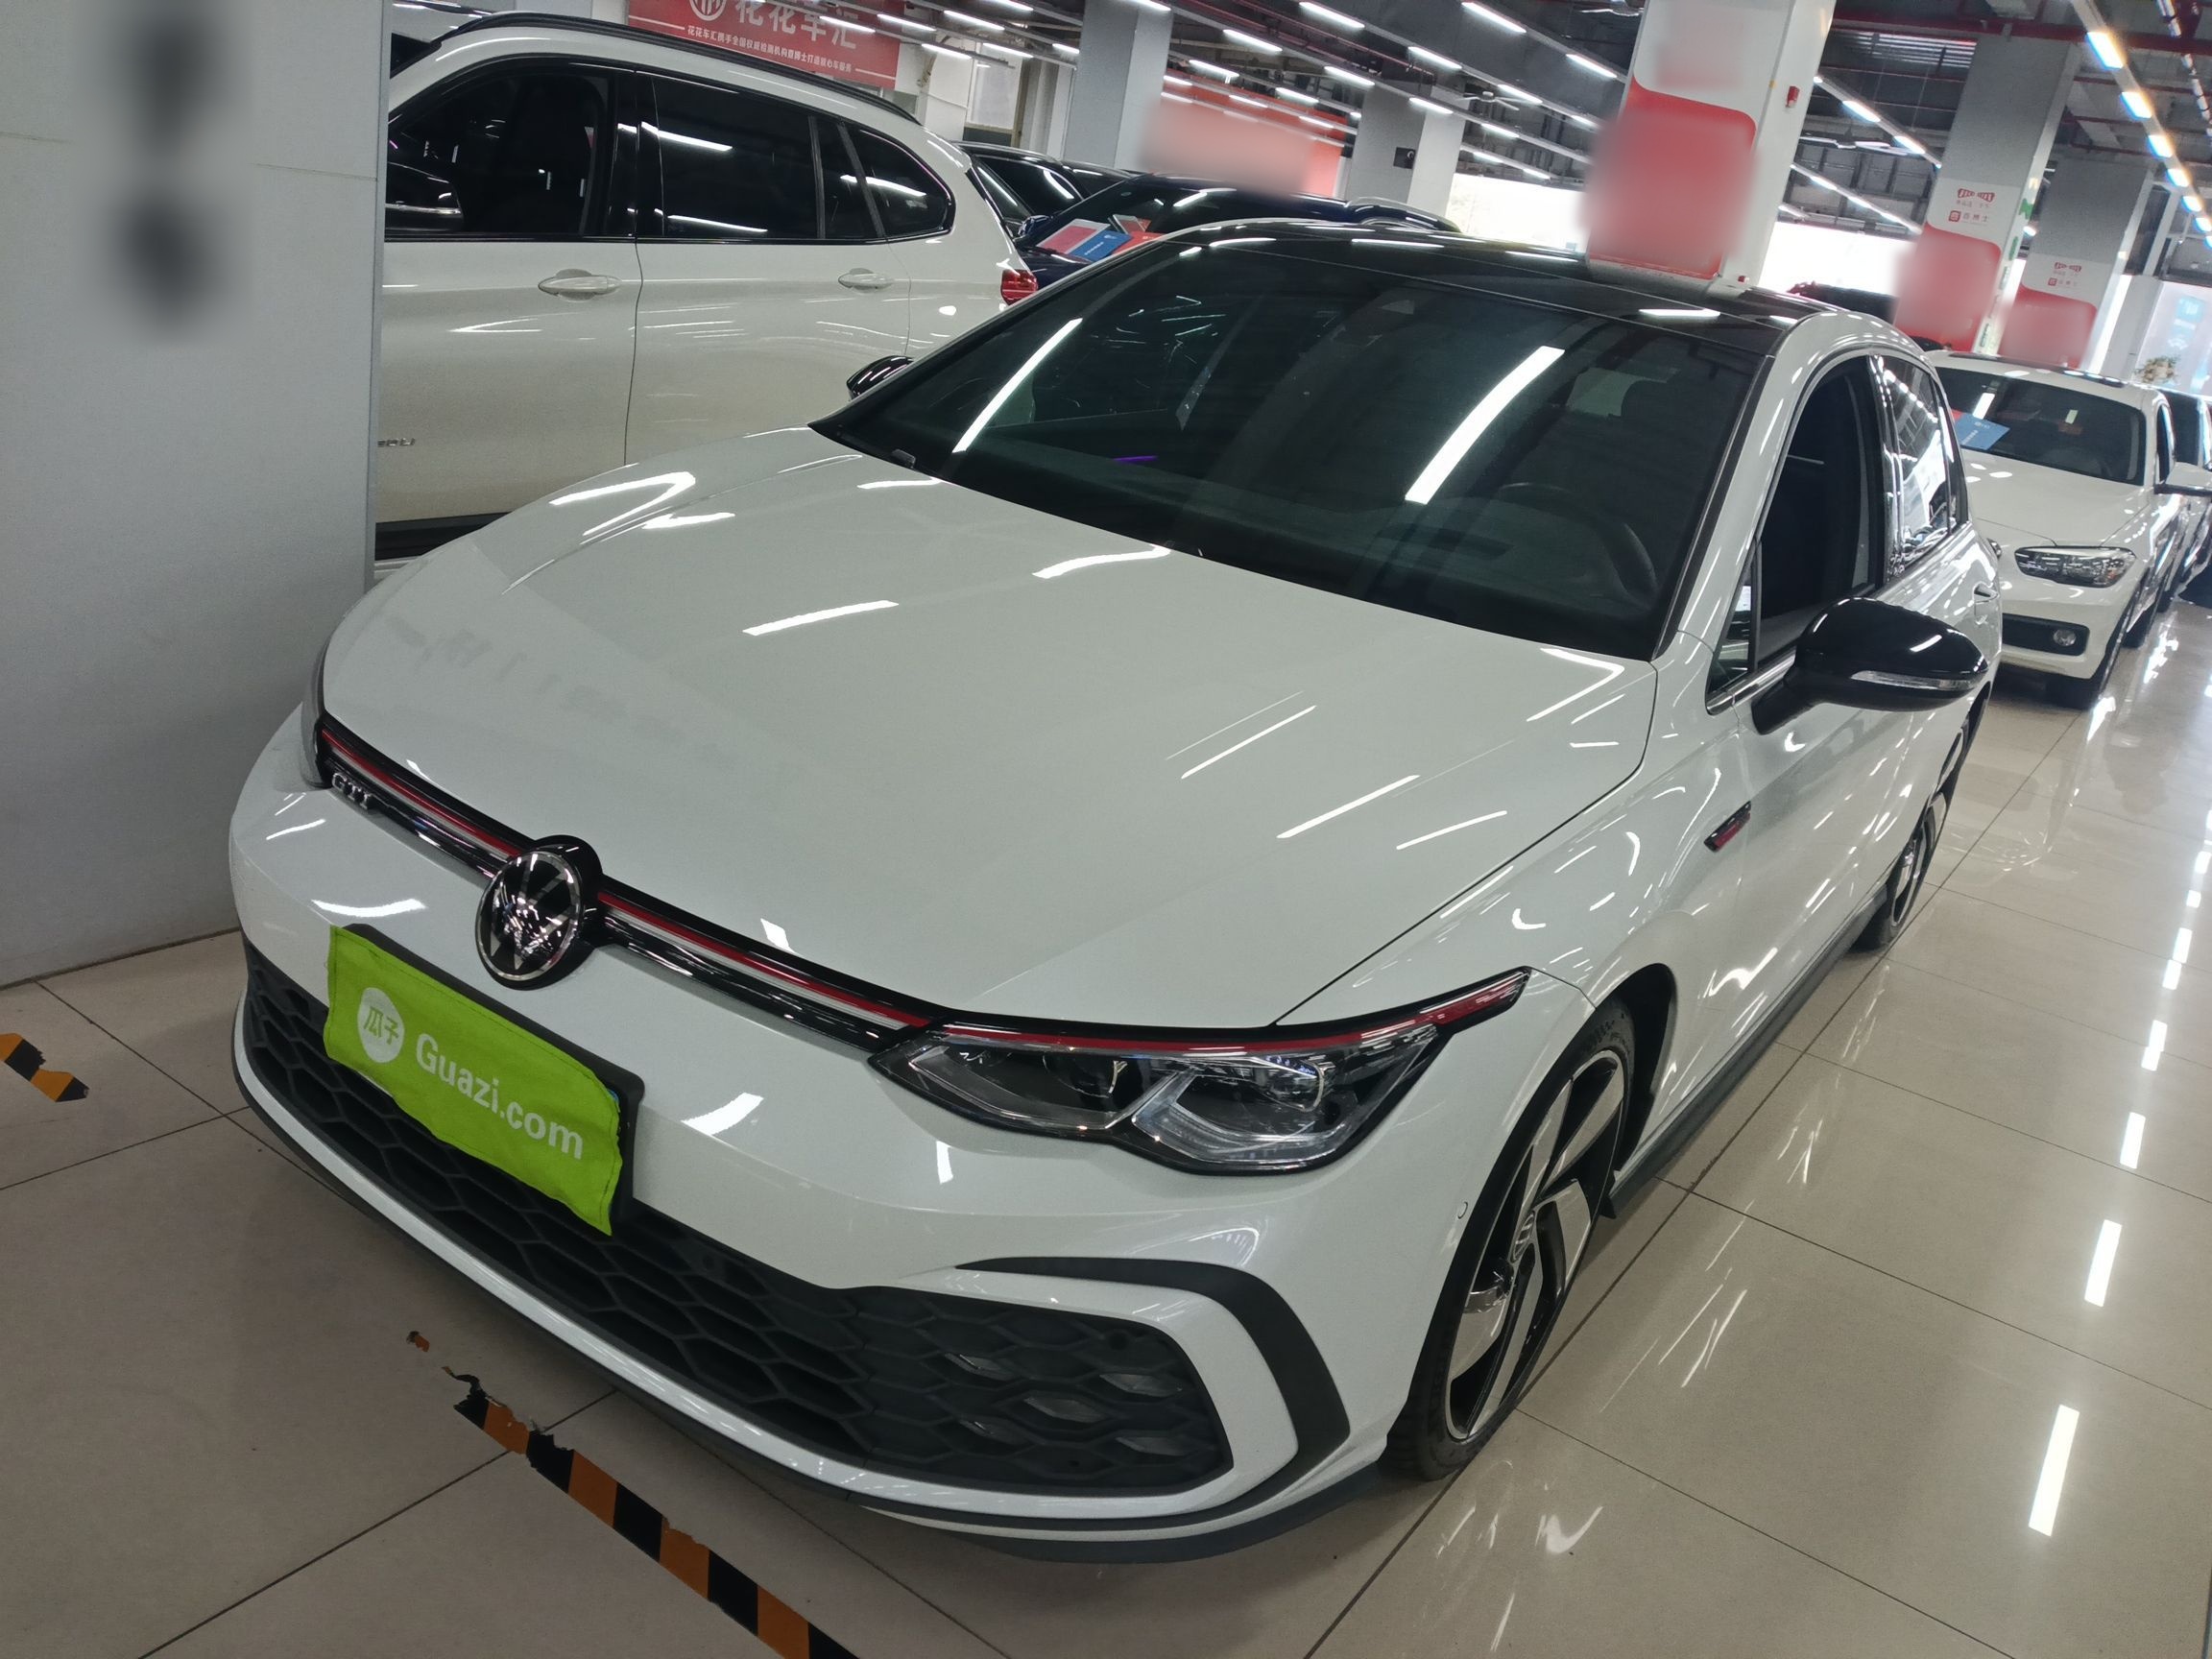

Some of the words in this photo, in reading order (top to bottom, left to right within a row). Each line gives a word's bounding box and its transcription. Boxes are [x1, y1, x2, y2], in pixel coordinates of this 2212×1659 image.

[331, 772, 369, 810] GTI
[364, 1006, 398, 1046] 瓜子
[416, 1032, 584, 1161] Guazi.com
